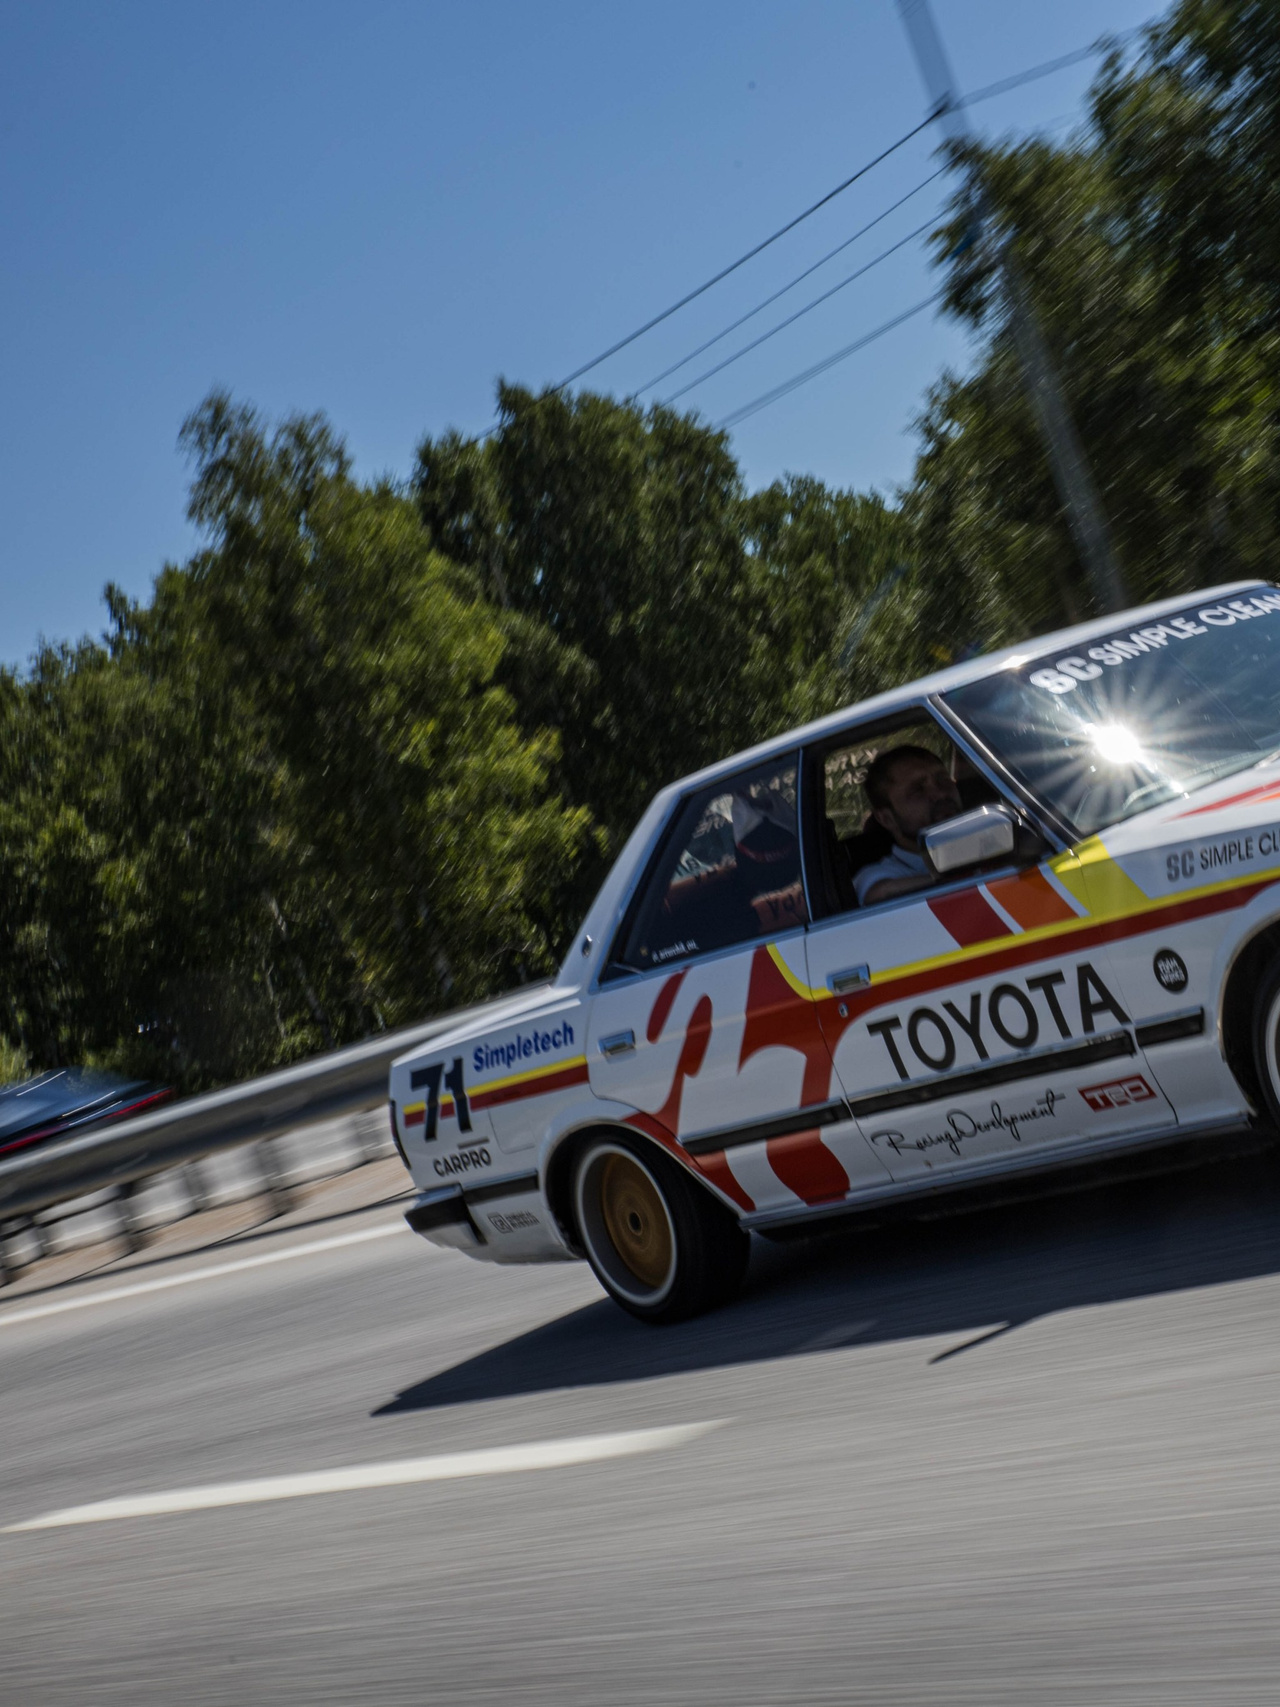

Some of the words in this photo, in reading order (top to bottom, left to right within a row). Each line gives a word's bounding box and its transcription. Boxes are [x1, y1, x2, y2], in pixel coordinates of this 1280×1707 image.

[1030, 656, 1103, 694] SC
[1089, 617, 1208, 666] SIMPLE
[1166, 849, 1195, 882] SC
[1199, 837, 1253, 870] SIMPLE
[472, 1020, 575, 1073] Simpletech
[866, 962, 1132, 1081] TOYOTA
[410, 1055, 473, 1143] 71
[1082, 1076, 1153, 1108] TRD
[433, 1148, 492, 1177] CARPRO
